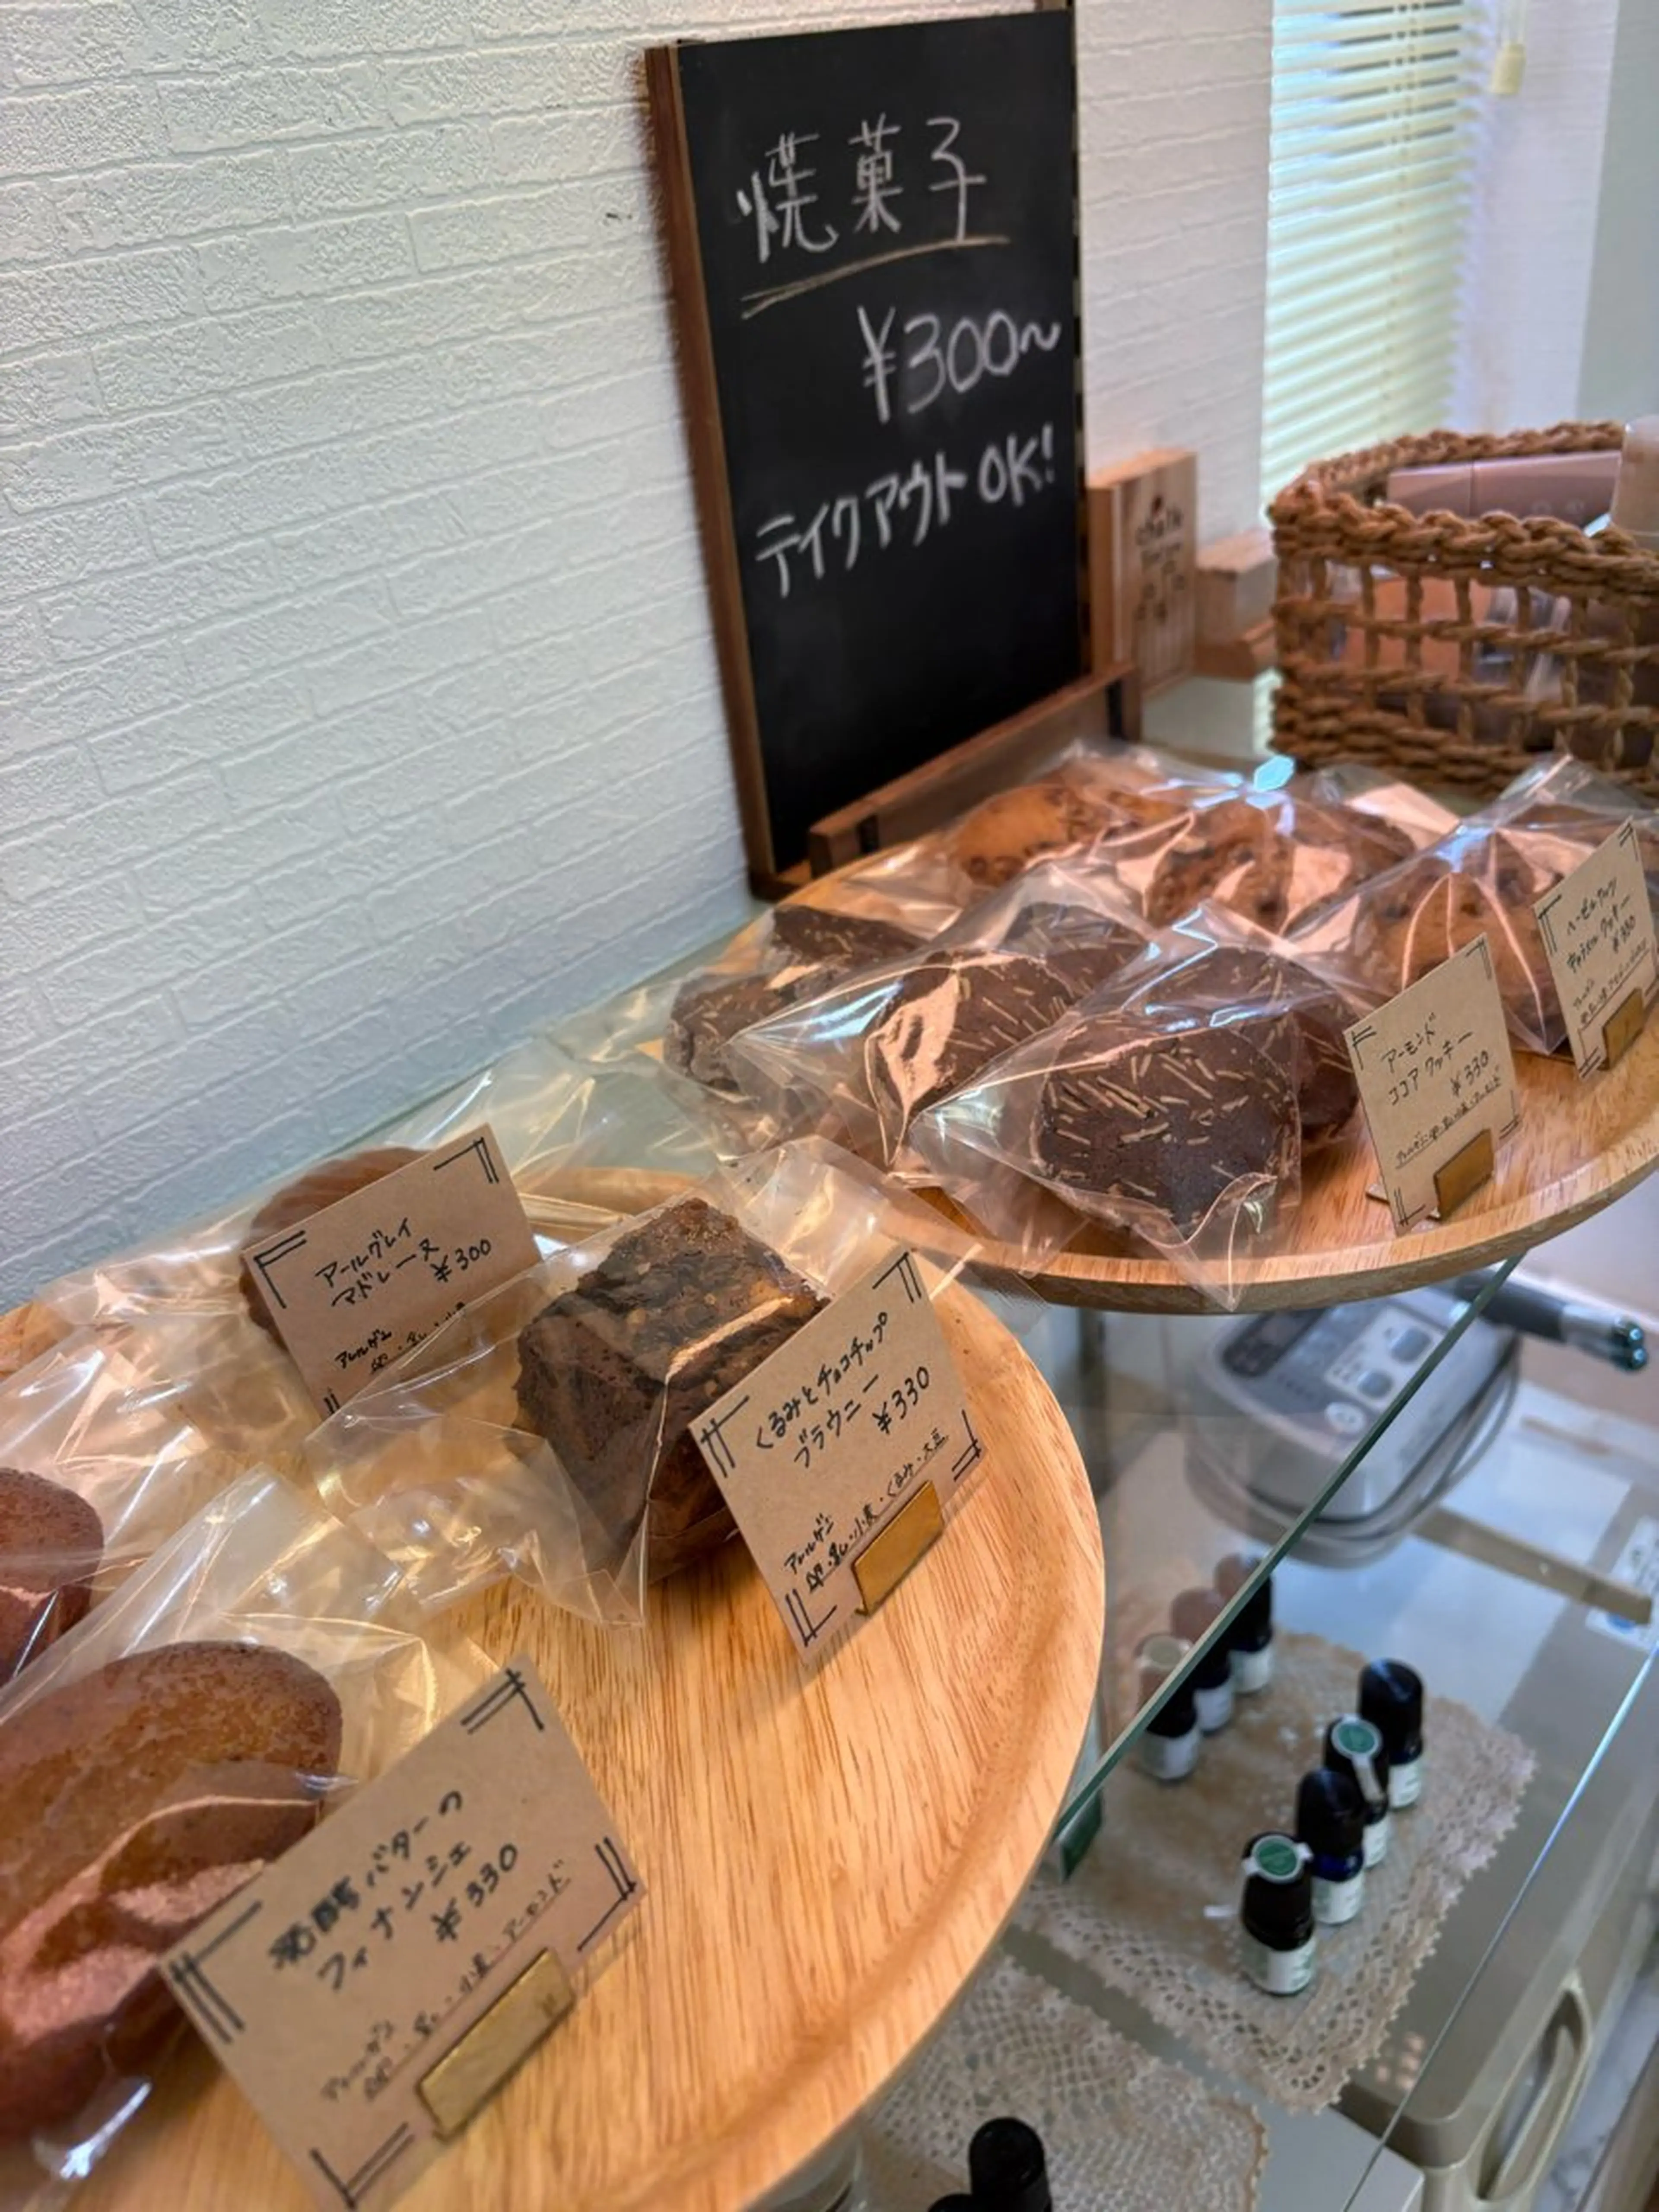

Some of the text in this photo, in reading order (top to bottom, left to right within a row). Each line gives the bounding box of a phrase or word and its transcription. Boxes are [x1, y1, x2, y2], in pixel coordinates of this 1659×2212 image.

[737, 112, 986, 263] 焼菓子
[1380, 1012, 1436, 1073] アーモンド
[315, 1217, 412, 1287] アールグレイ
[331, 1239, 439, 1306] マドレーヌ
[430, 1239, 492, 1282] ¥300
[755, 1311, 888, 1451] くるみとチョコチップ
[871, 1366, 930, 1435] ¥330
[794, 1374, 879, 1468] ブラウニー
[784, 1513, 835, 1574] アレルゲン
[317, 1841, 472, 1990] フィナンシェ
[431, 1842, 517, 1945] ¥330
